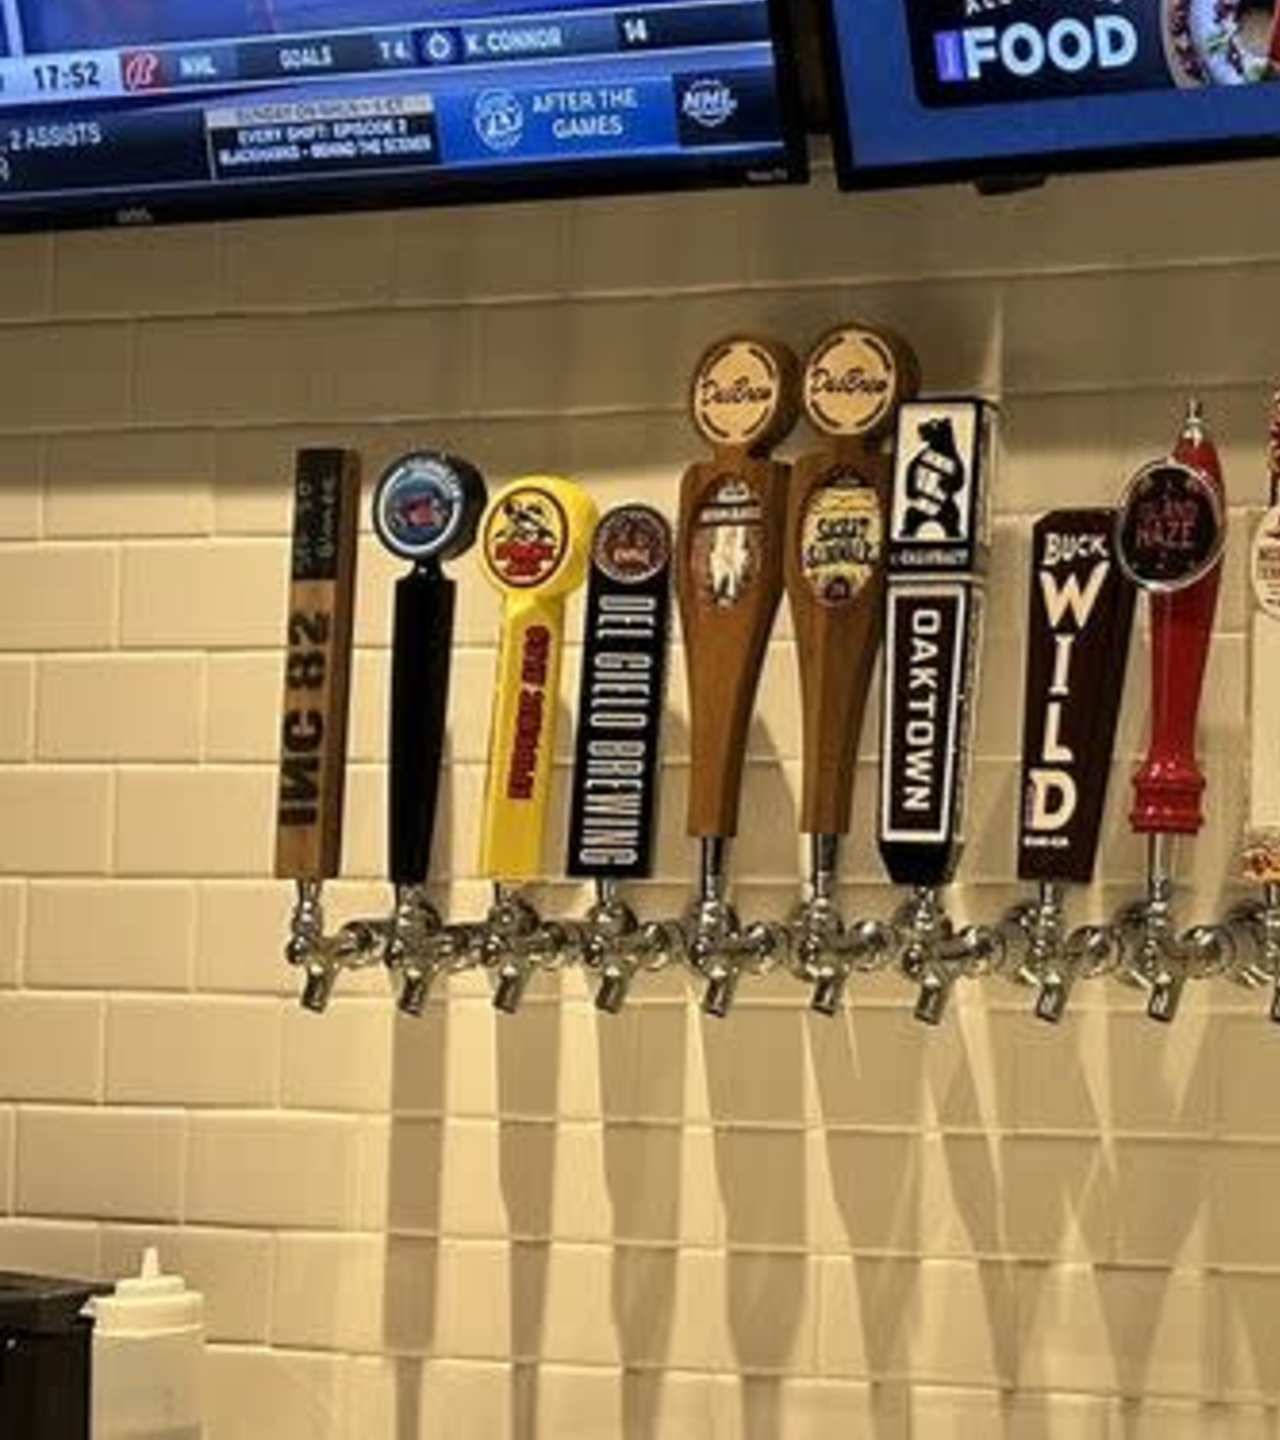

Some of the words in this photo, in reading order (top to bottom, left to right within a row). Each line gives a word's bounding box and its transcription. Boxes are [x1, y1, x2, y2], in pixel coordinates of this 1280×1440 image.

[33, 61, 100, 91] 17:52
[532, 89, 597, 114] AFTER
[600, 86, 639, 111] THE
[25, 120, 103, 150] ASSISTS
[551, 115, 624, 139] GAMES
[1043, 532, 1110, 567] BUCK
[596, 594, 658, 638] DEL
[590, 652, 653, 729] CIELO
[901, 608, 943, 812] OAKTOWN
[1027, 561, 1111, 832] WILD
[578, 739, 646, 866] BREWING
